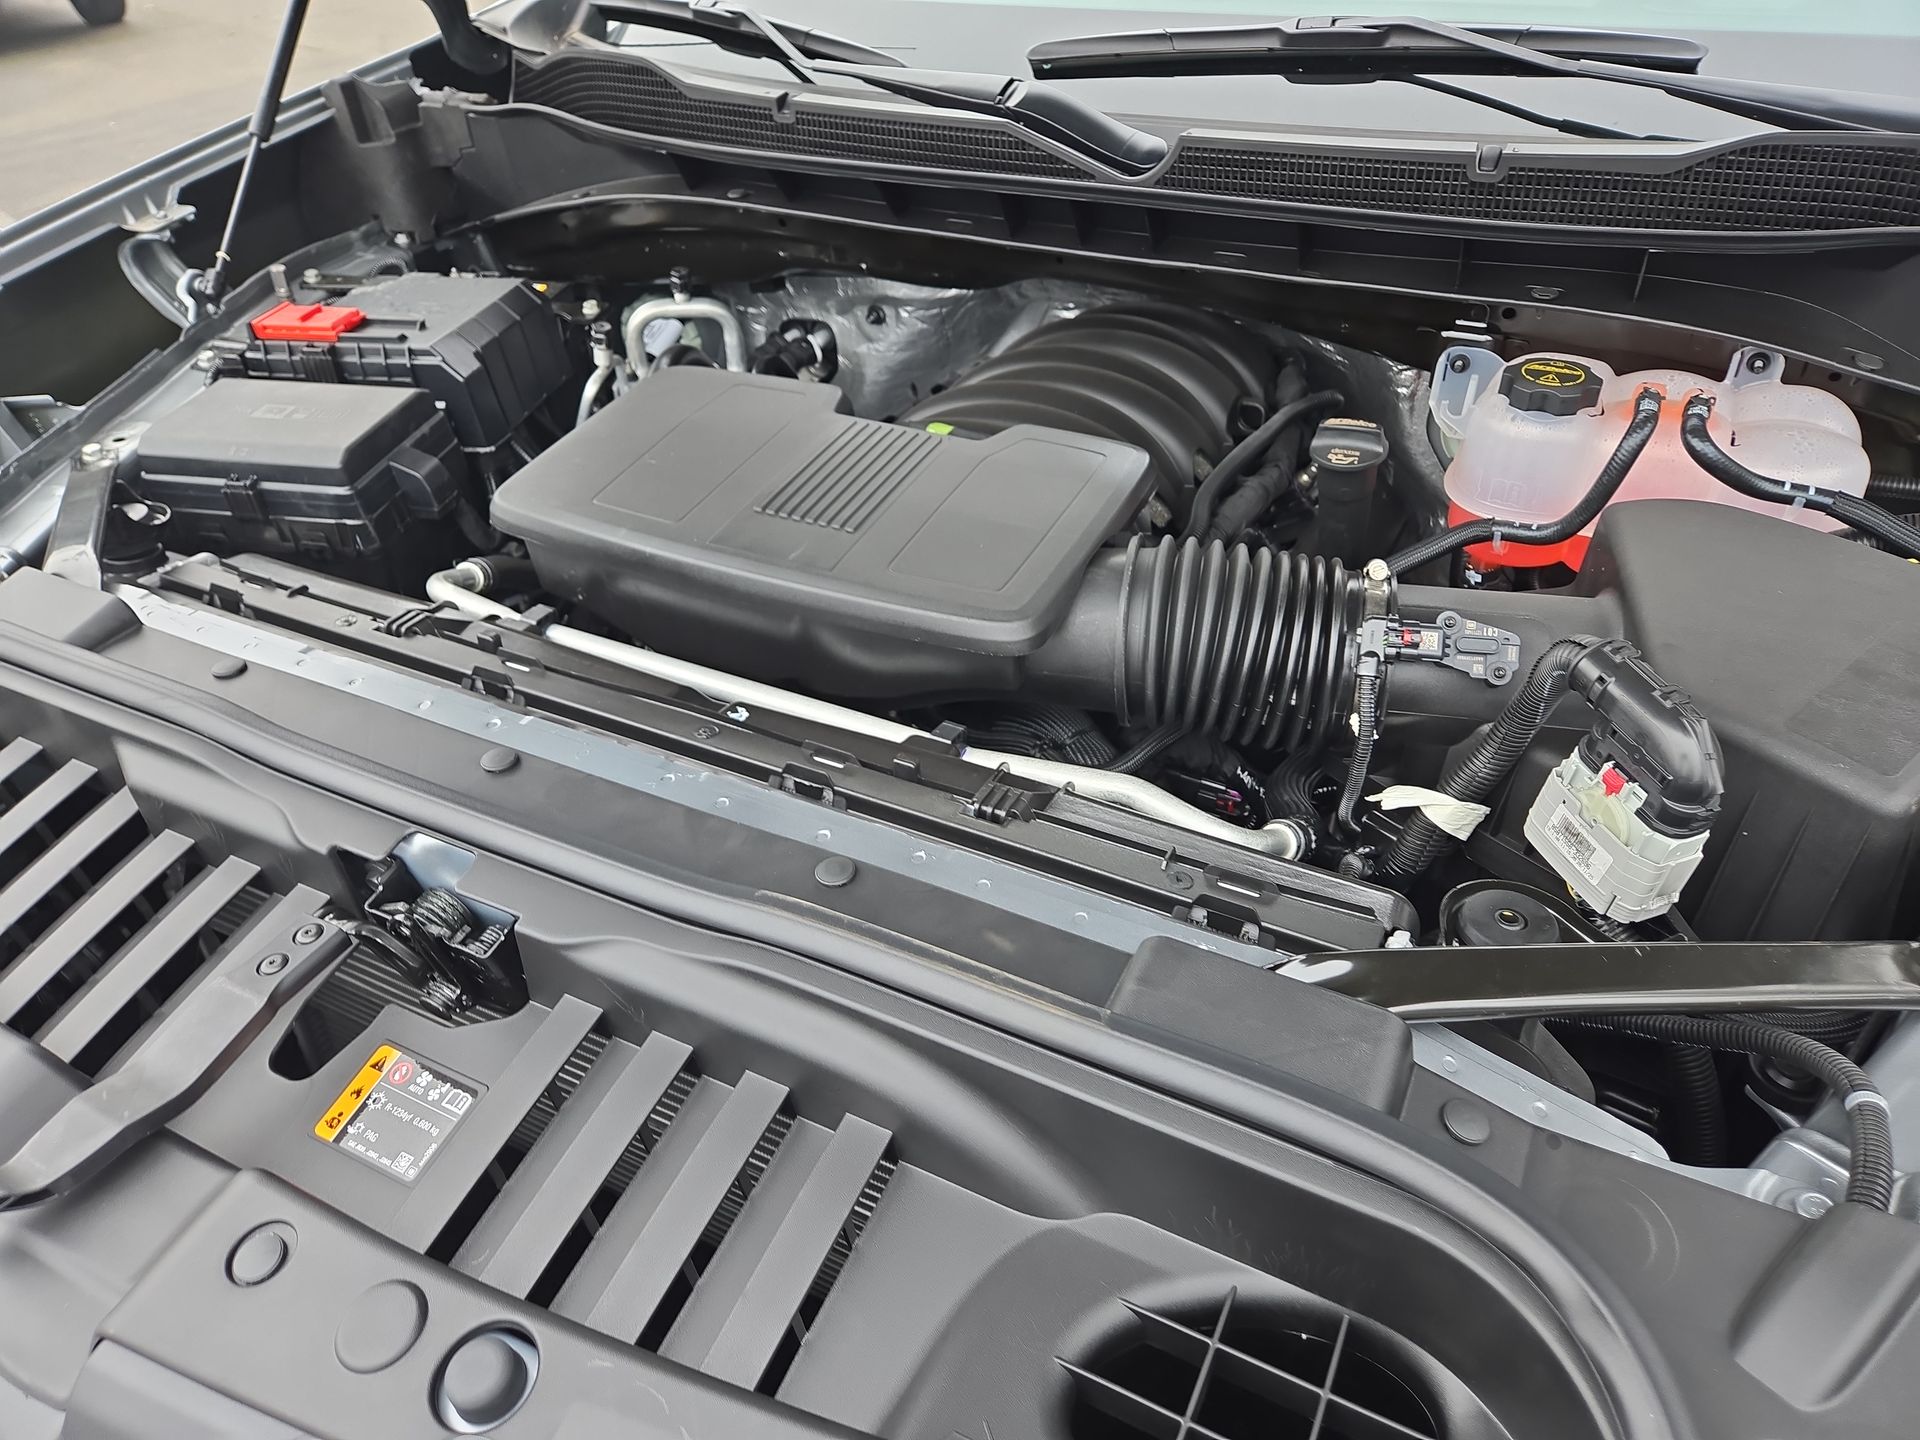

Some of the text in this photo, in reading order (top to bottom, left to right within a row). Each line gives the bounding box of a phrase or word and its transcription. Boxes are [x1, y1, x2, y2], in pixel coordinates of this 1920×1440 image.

[407, 1083, 425, 1095] AUTO
[384, 1102, 414, 1122] R-1234yf
[429, 1125, 440, 1137] kg
[363, 1129, 379, 1142] PAG
